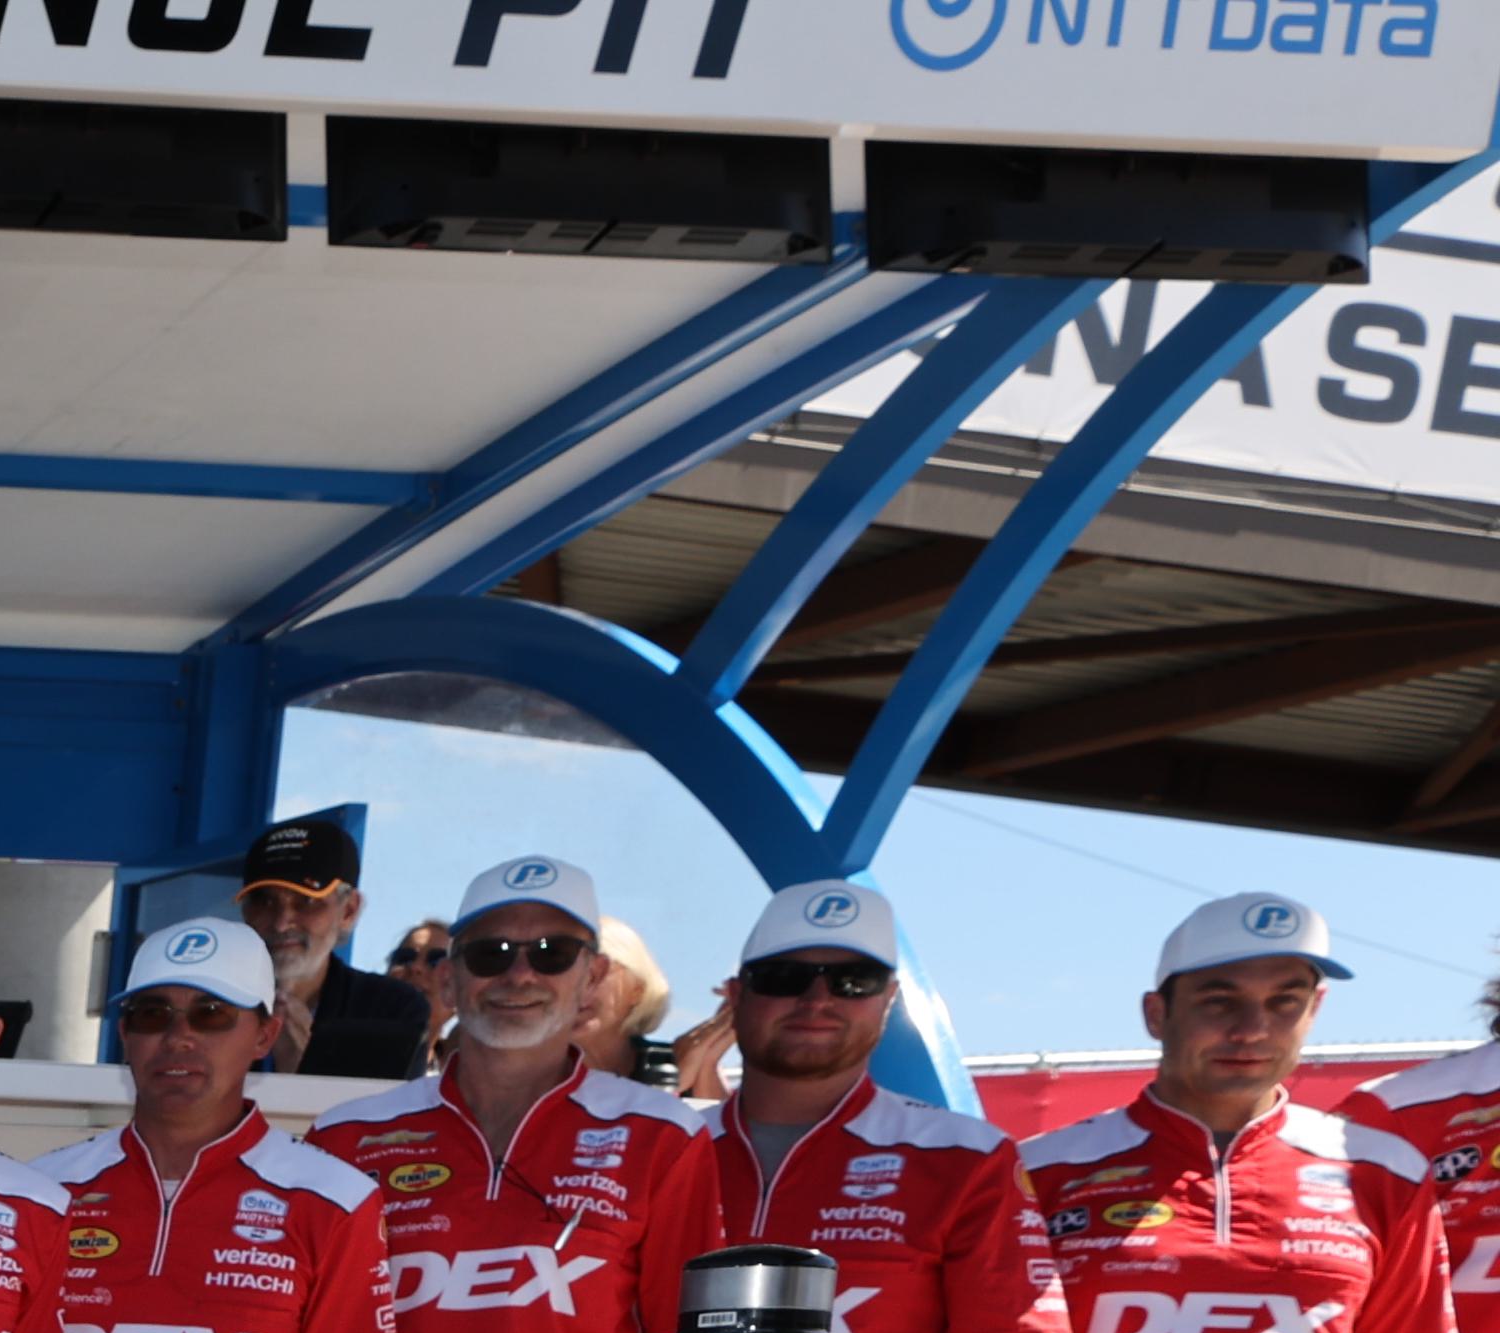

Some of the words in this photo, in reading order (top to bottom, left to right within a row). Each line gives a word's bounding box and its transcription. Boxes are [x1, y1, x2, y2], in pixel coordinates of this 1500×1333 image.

[552, 1173, 628, 1201] verizon
[819, 1204, 906, 1225] verizon
[213, 1246, 296, 1271] verizon
[1281, 1239, 1369, 1262] HITACHI
[205, 1272, 294, 1295] HITACHI
[388, 1245, 608, 1317] DEX
